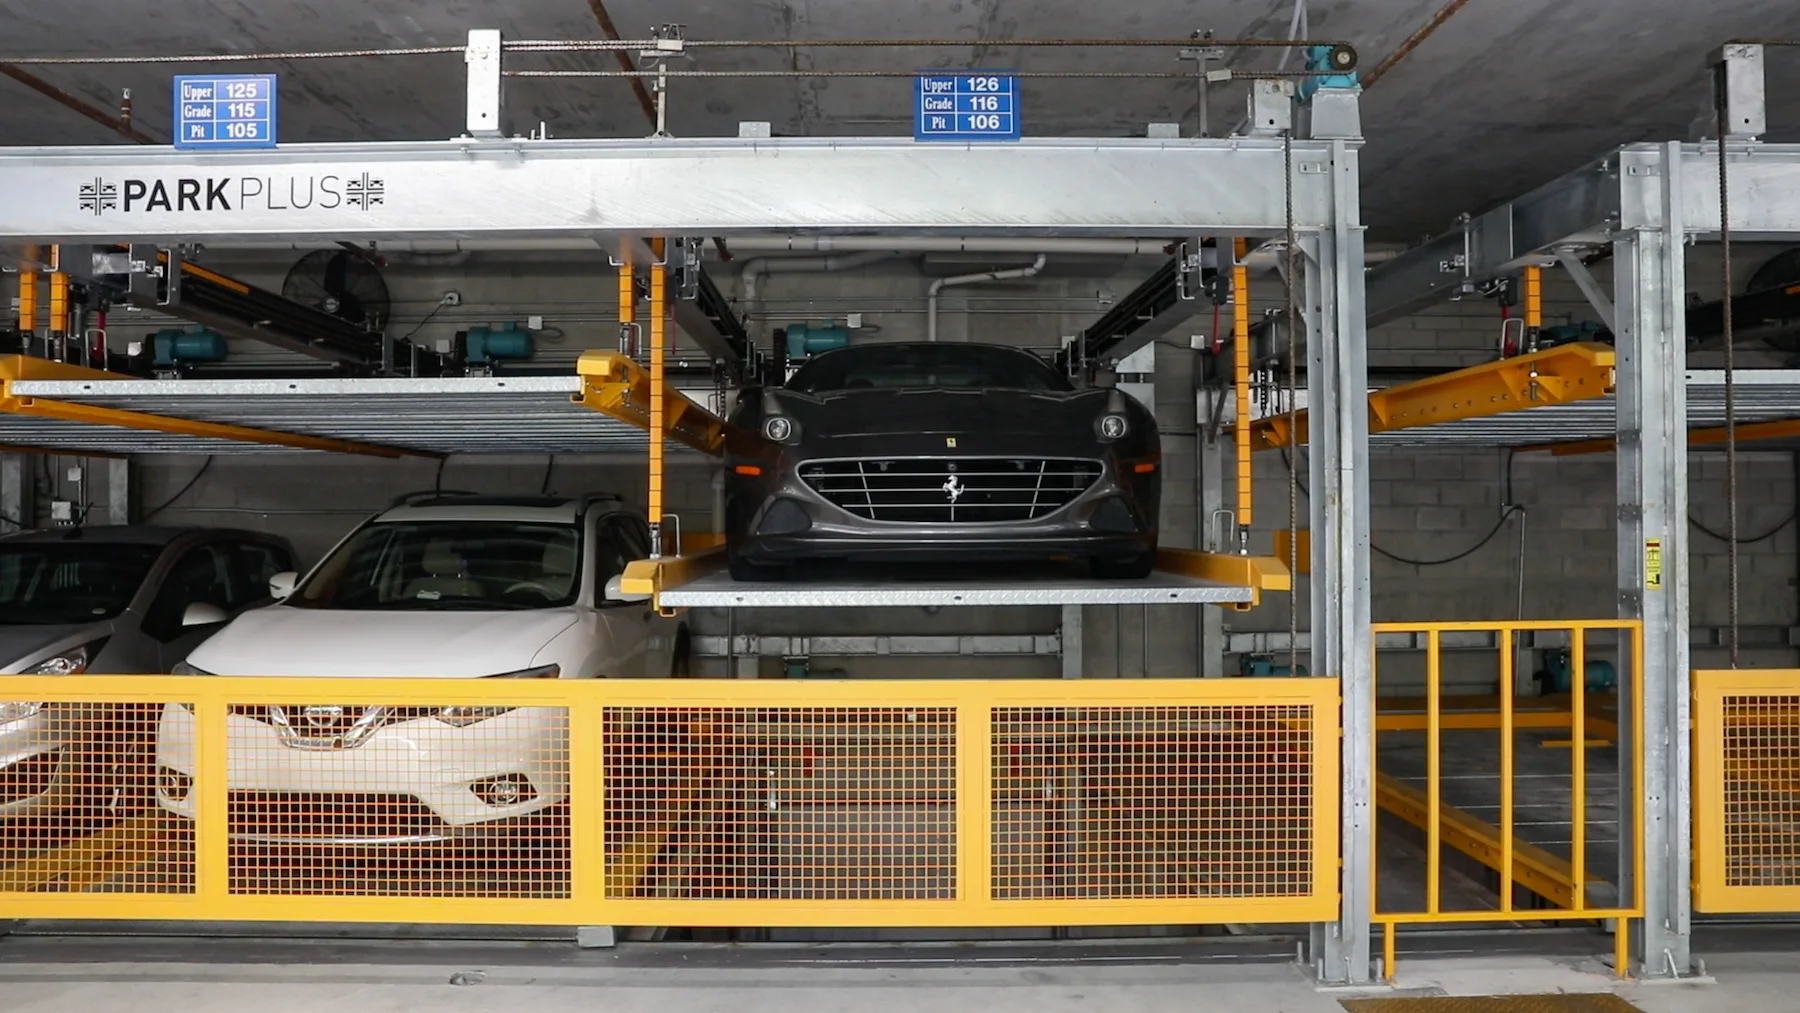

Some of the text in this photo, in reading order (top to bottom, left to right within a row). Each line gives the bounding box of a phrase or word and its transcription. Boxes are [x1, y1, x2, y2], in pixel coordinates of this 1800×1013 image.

[184, 83, 257, 100] Upper 125
[924, 77, 999, 93] Upper 126
[184, 103, 256, 118] Grade 115
[925, 96, 998, 111] Grade 116
[932, 115, 1000, 129] Pit 106
[190, 123, 257, 138] Pit 105
